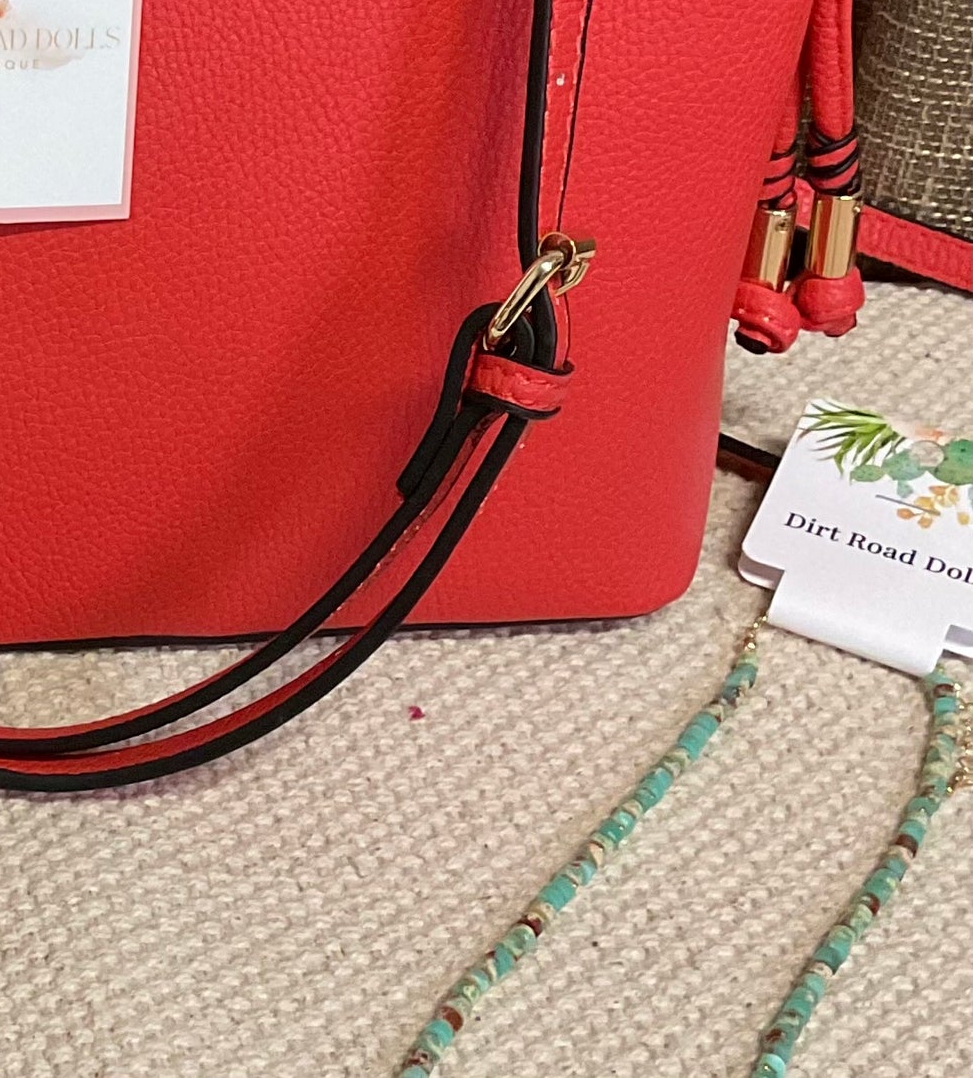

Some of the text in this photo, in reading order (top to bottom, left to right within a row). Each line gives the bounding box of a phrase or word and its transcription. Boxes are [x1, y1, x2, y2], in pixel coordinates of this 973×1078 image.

[36, 26, 121, 50] DOLLS
[784, 512, 841, 542] Dirt
[846, 532, 917, 566] Road
